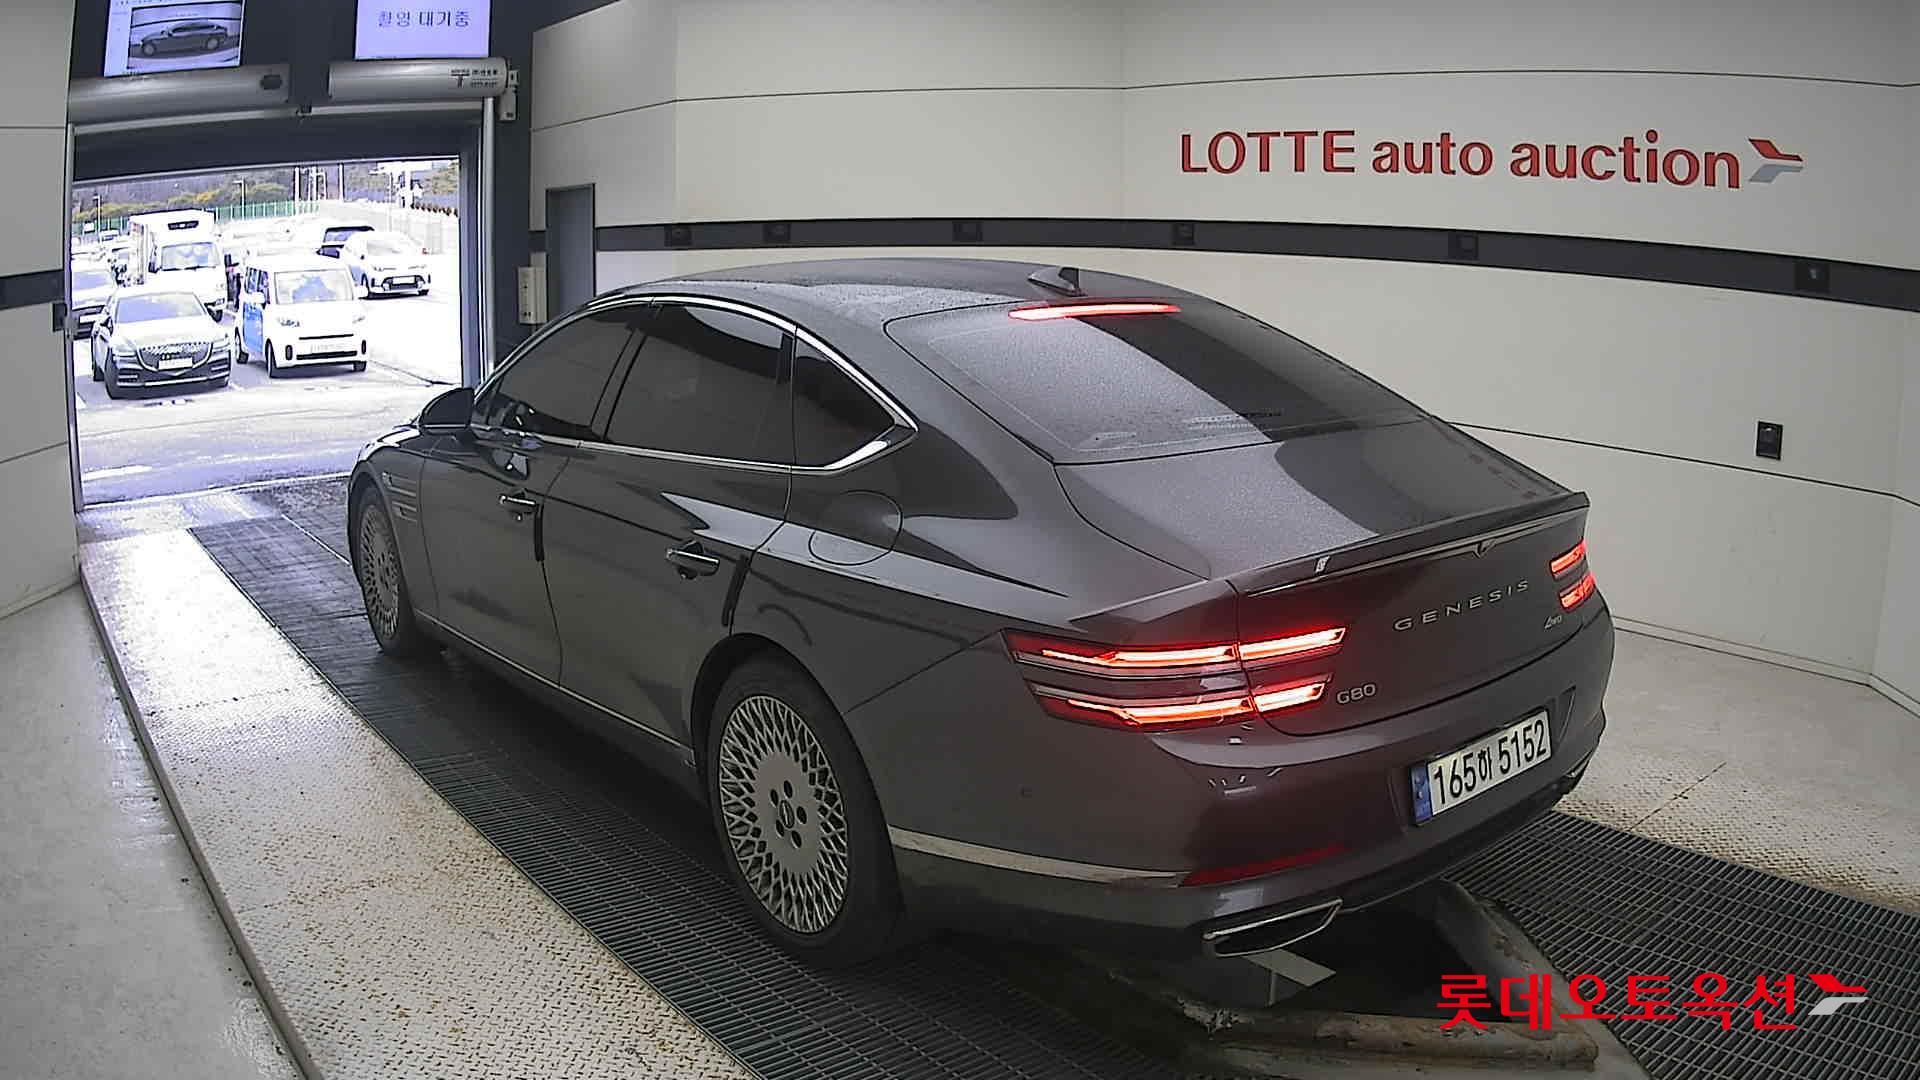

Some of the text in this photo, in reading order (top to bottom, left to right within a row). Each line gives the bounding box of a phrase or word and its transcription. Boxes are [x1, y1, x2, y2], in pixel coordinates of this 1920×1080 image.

[1180, 129, 1741, 189] LOTTE auto auction
[1393, 579, 1530, 632] GENESIS
[1335, 683, 1377, 705] G80
[1433, 719, 1547, 805] 165하 5152
